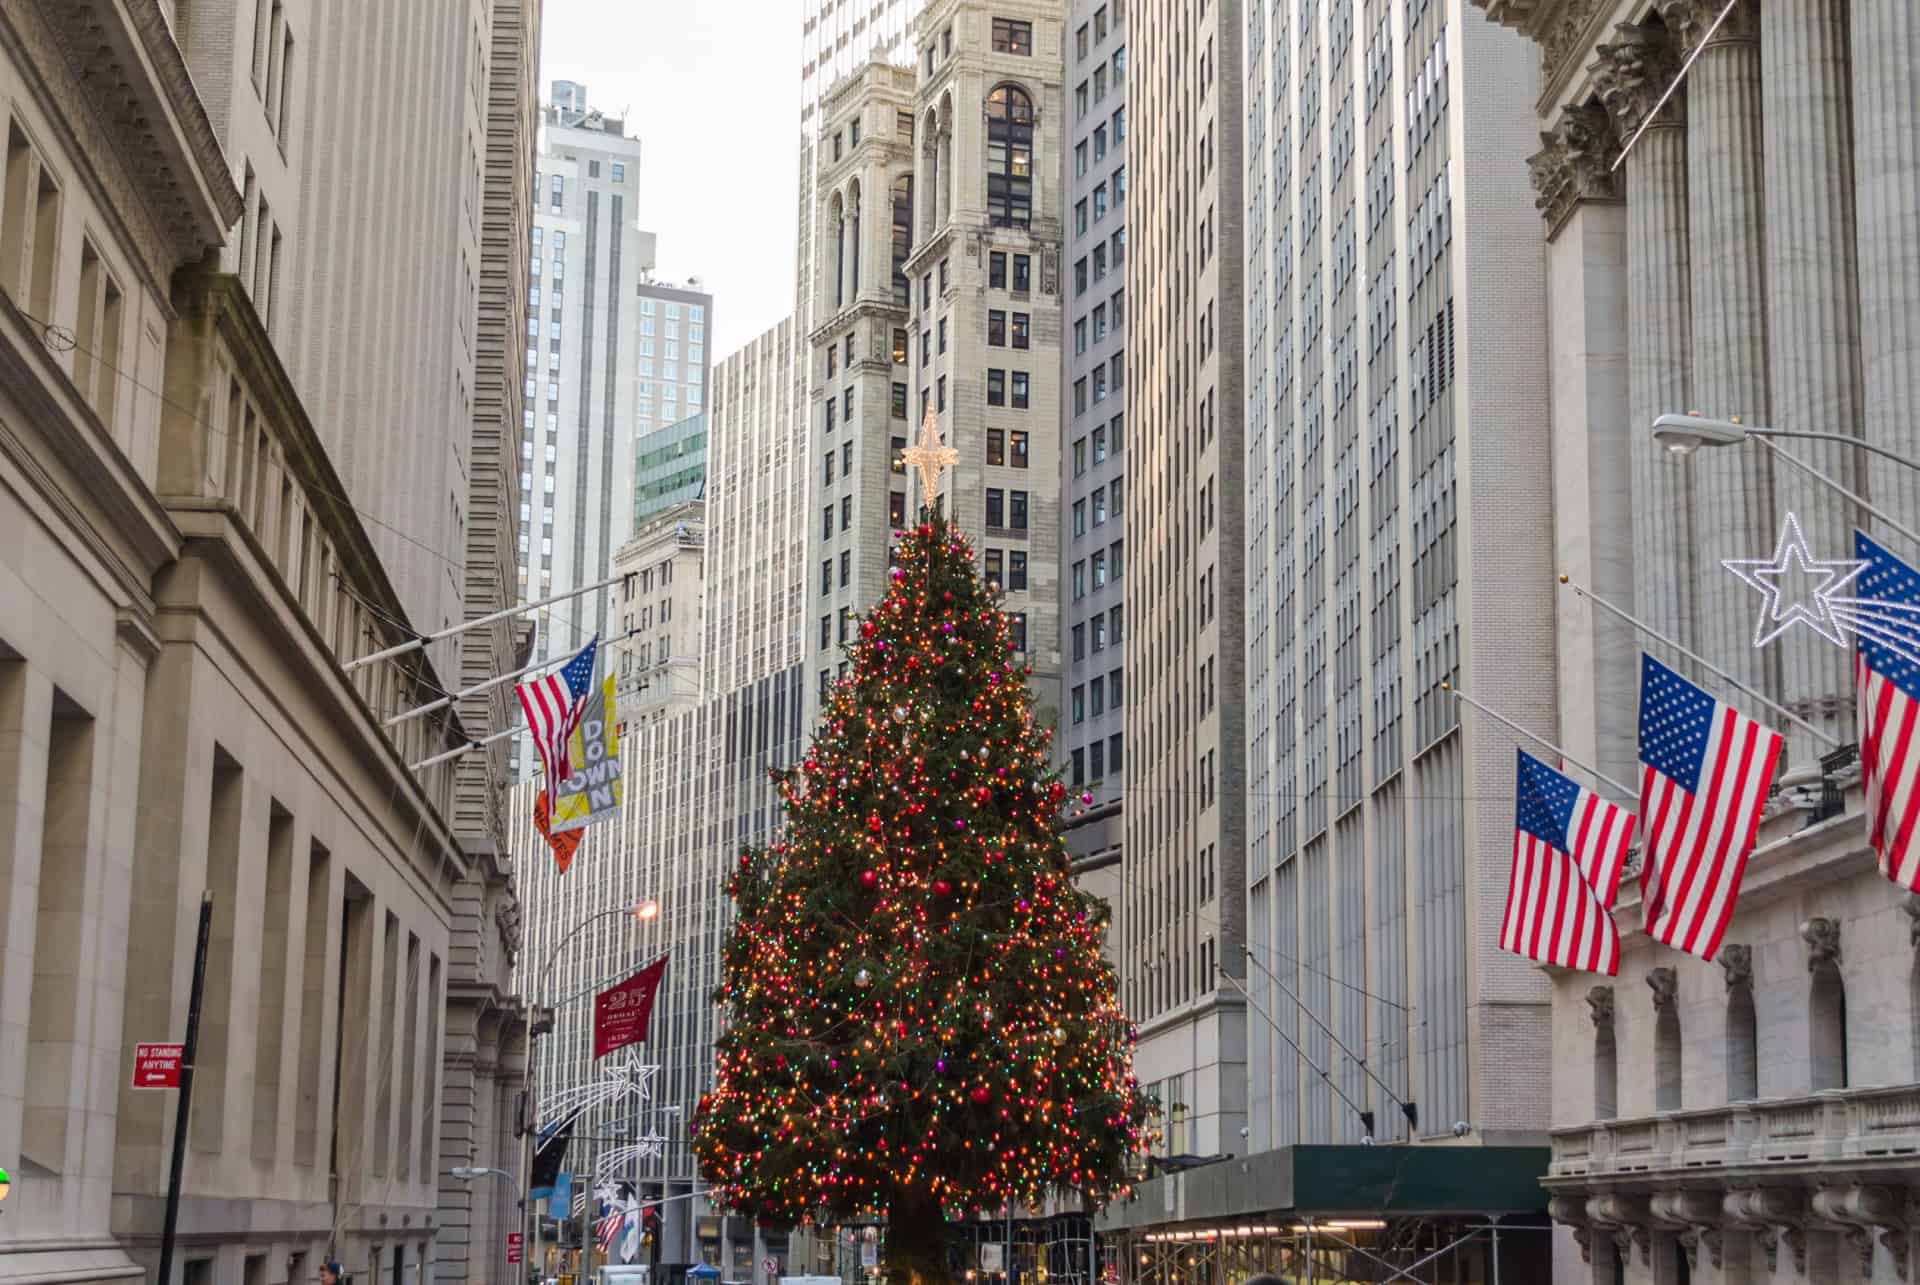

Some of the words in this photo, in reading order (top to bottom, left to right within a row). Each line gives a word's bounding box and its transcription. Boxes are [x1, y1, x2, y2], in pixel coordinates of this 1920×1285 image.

[607, 986, 646, 1010] 25
[139, 1047, 149, 1057] NO
[150, 1047, 182, 1057] STANDING
[142, 1059, 176, 1070] ANYTIME
